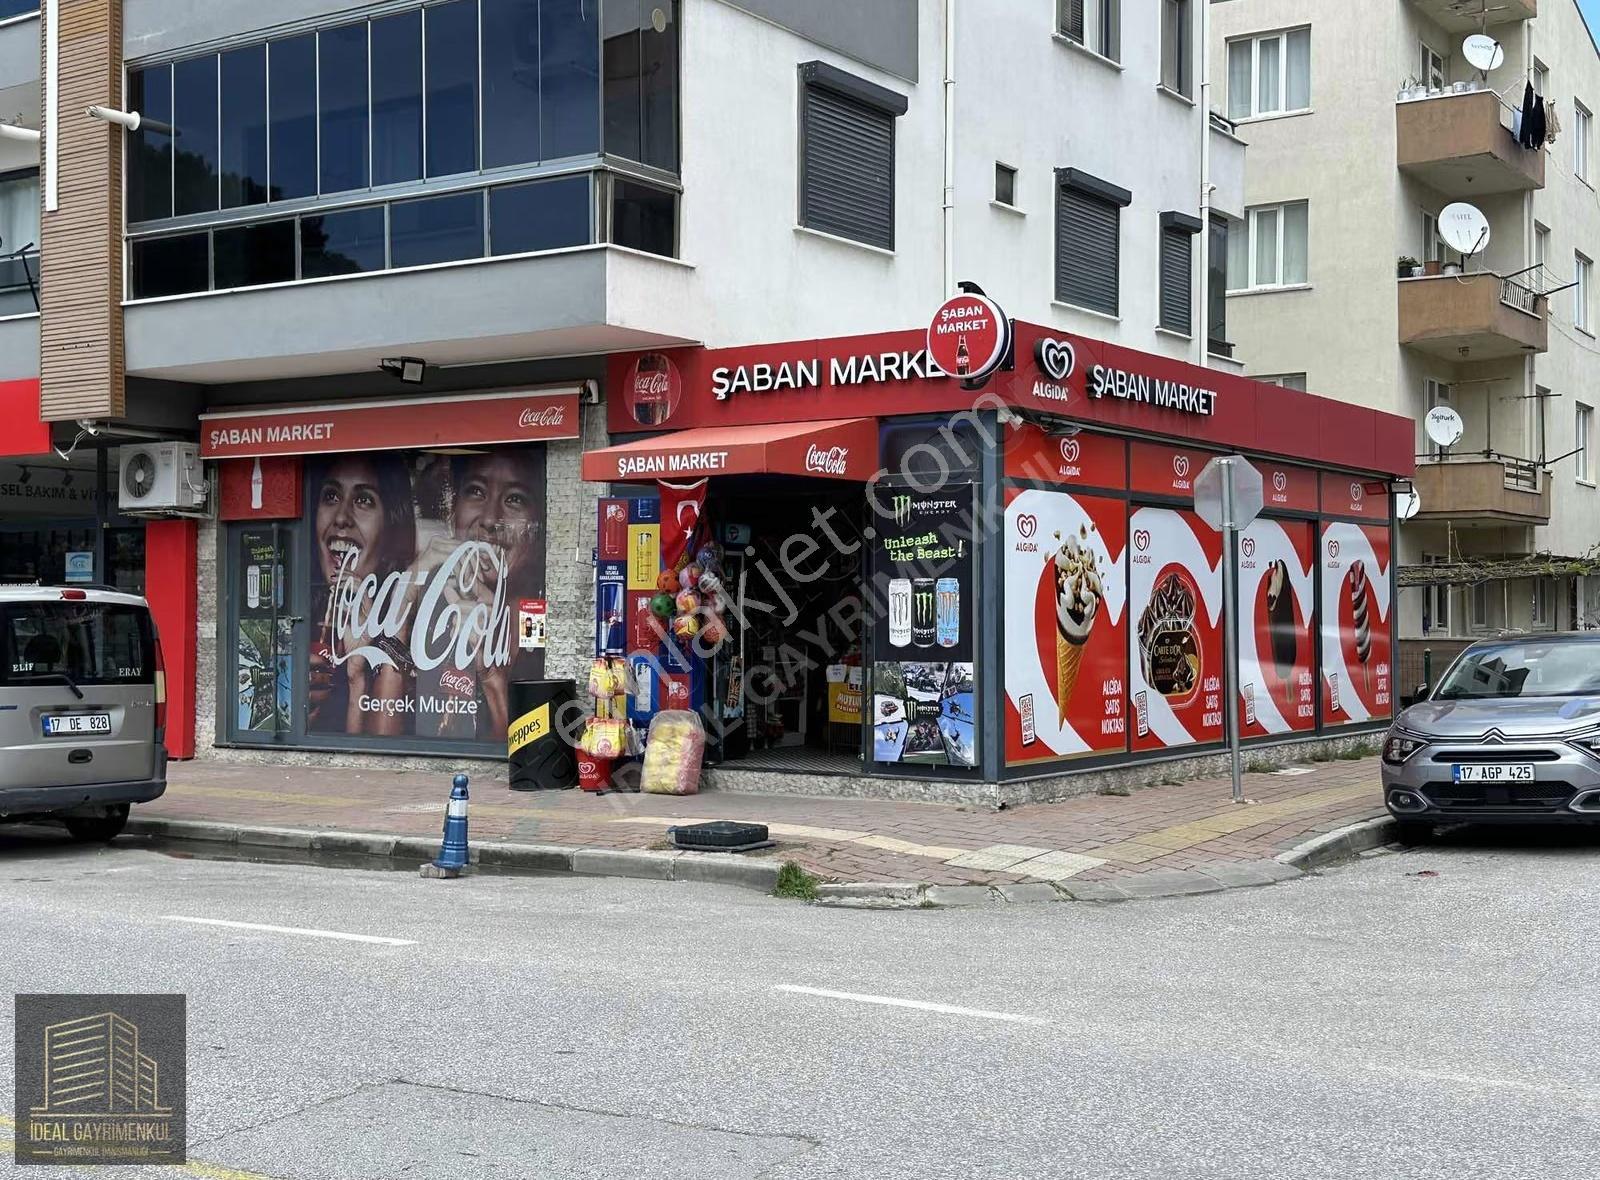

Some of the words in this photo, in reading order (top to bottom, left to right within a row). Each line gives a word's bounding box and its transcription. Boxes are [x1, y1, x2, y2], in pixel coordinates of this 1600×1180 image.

[941, 305, 983, 322] ŞABAN
[937, 319, 989, 334] MARKET
[711, 359, 818, 400] ŞABAN
[830, 350, 946, 386] MARKE
[1092, 364, 1150, 403] ŞABAN
[1155, 378, 1217, 416] MARKET
[518, 405, 566, 428] Coca-Cola
[211, 427, 262, 449] ŞABAN
[267, 423, 334, 443] MARKET
[618, 455, 665, 478] ŞABAN
[669, 452, 728, 472] MARKET
[806, 443, 849, 475] Coca-Cola
[884, 531, 939, 550] Unleash
[890, 550, 914, 562] the
[331, 541, 511, 671] Coca-Cola
[439, 670, 474, 697] Coca-Cola
[358, 695, 415, 716] Gerçek
[50, 718, 60, 731] 17
[70, 718, 82, 730] DE
[90, 716, 108, 729] 828
[1101, 717, 1124, 735] NOKTASI
[1461, 767, 1473, 779] 17
[1481, 767, 1502, 779] AGP
[1509, 766, 1531, 779] 425
